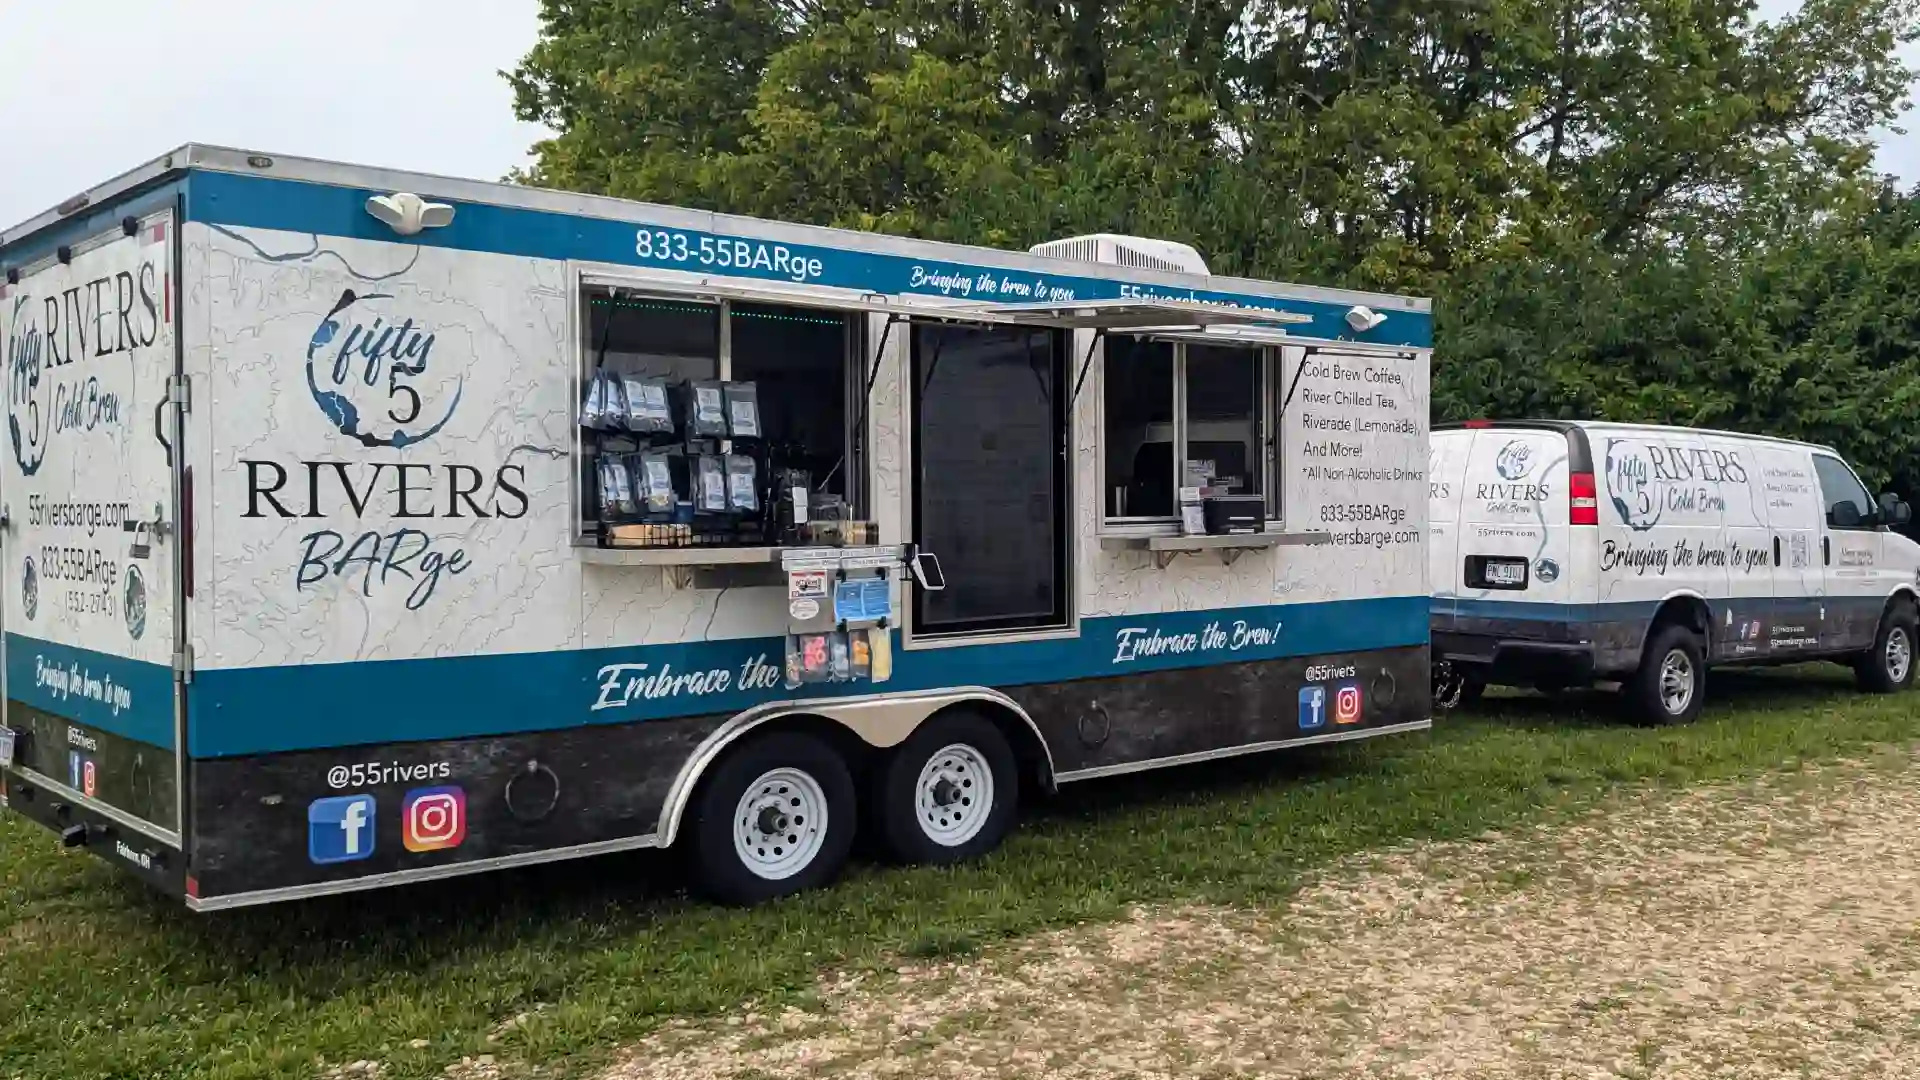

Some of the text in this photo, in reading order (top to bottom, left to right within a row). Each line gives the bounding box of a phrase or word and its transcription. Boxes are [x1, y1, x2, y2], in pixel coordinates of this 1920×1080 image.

[636, 229, 823, 281] 833-55BARge
[909, 265, 1075, 303] Bringing the brew to you
[44, 261, 157, 368] RIVERS
[332, 317, 436, 386] fifty
[388, 362, 426, 424] 5
[1303, 361, 1405, 388] Cold Brew Coffee,
[55, 375, 120, 434] Cold Brew
[1303, 387, 1397, 410] River Chilled Tea,
[1303, 413, 1420, 436] Riverade (Lemonade),
[1303, 440, 1363, 458] And More!
[1324, 467, 1392, 480] Non-Alcoholic
[1394, 467, 1423, 480] Drinks
[1617, 445, 1748, 492] fifty RIVERS
[238, 459, 530, 520] RIVERS
[1476, 483, 1550, 502] RIVERS
[1636, 479, 1650, 514] 5
[1668, 487, 1725, 513] Cold Brew
[29, 491, 130, 537] 55riversbarge.com
[1321, 504, 1405, 525] 833-55BARge
[1304, 528, 1420, 549] versbarge.com
[1600, 538, 1769, 576] Bringing the brew to you
[42, 545, 117, 595] 833-55BARge
[296, 527, 473, 611] BARge
[1113, 620, 1282, 664] Embrace the Brew!
[35, 654, 132, 716] Bringing the brew to you
[591, 663, 732, 711] Embrace
[737, 652, 780, 690] the
[1305, 664, 1356, 682] @55rivers
[327, 761, 451, 788] @55rivers
